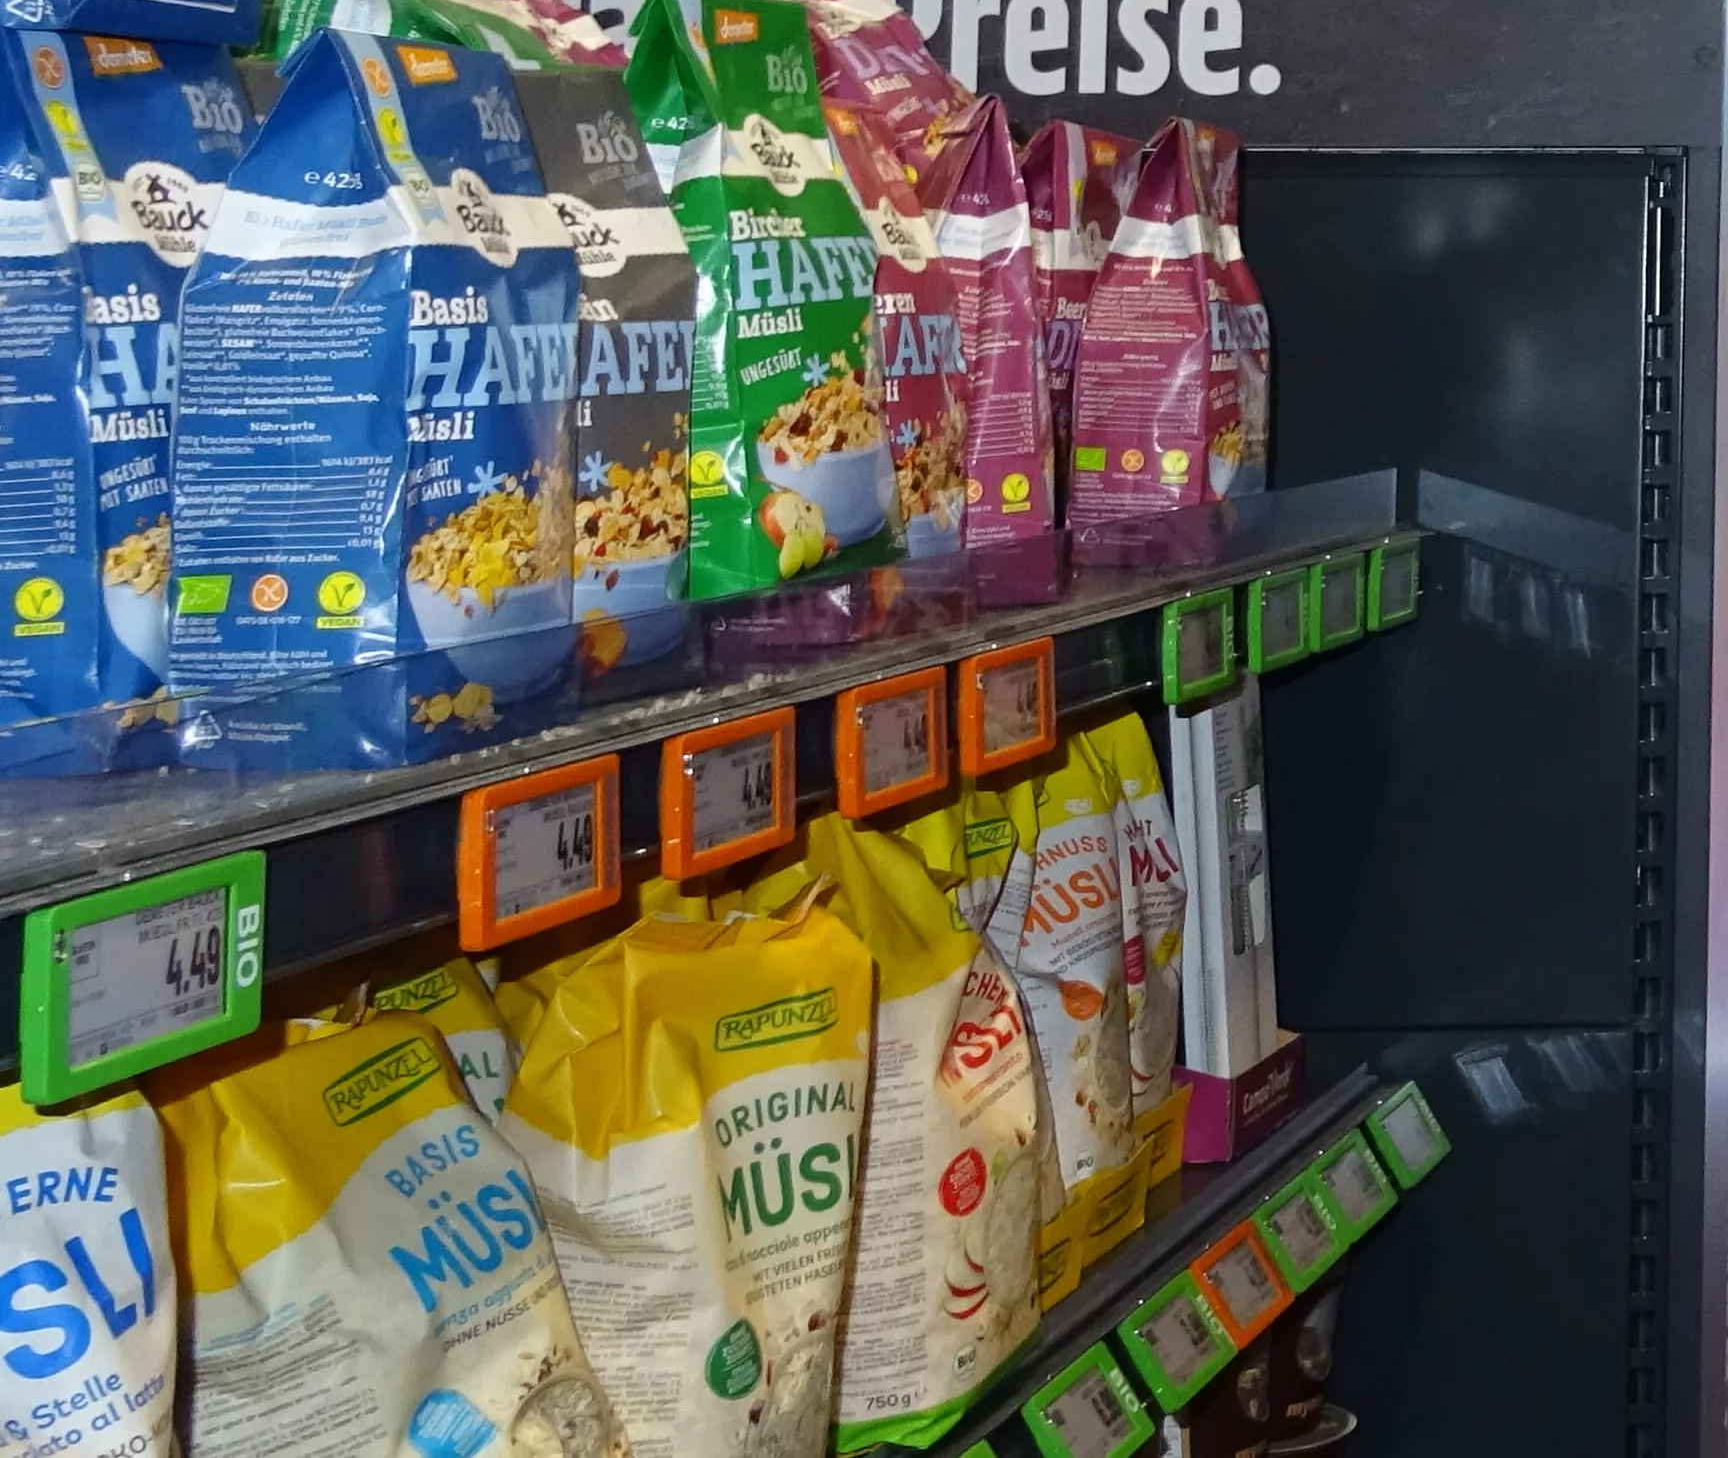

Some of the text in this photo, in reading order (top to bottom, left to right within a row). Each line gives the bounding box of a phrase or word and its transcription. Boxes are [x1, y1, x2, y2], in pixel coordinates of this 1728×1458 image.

[131, 199, 209, 234] Bauck
[409, 285, 490, 327] Basis
[737, 308, 804, 339] Müsli
[89, 408, 170, 443] Müsli
[556, 814, 594, 877] 4.49
[165, 903, 261, 997] 4.49 BIO
[330, 1047, 434, 1116] RAPUNZEL
[714, 1079, 857, 1149] ORIGINAL
[384, 1123, 481, 1199] BASIS
[30, 1372, 124, 1430] Stelle
[90, 1405, 120, 1434] al
[865, 1393, 898, 1411] 750
